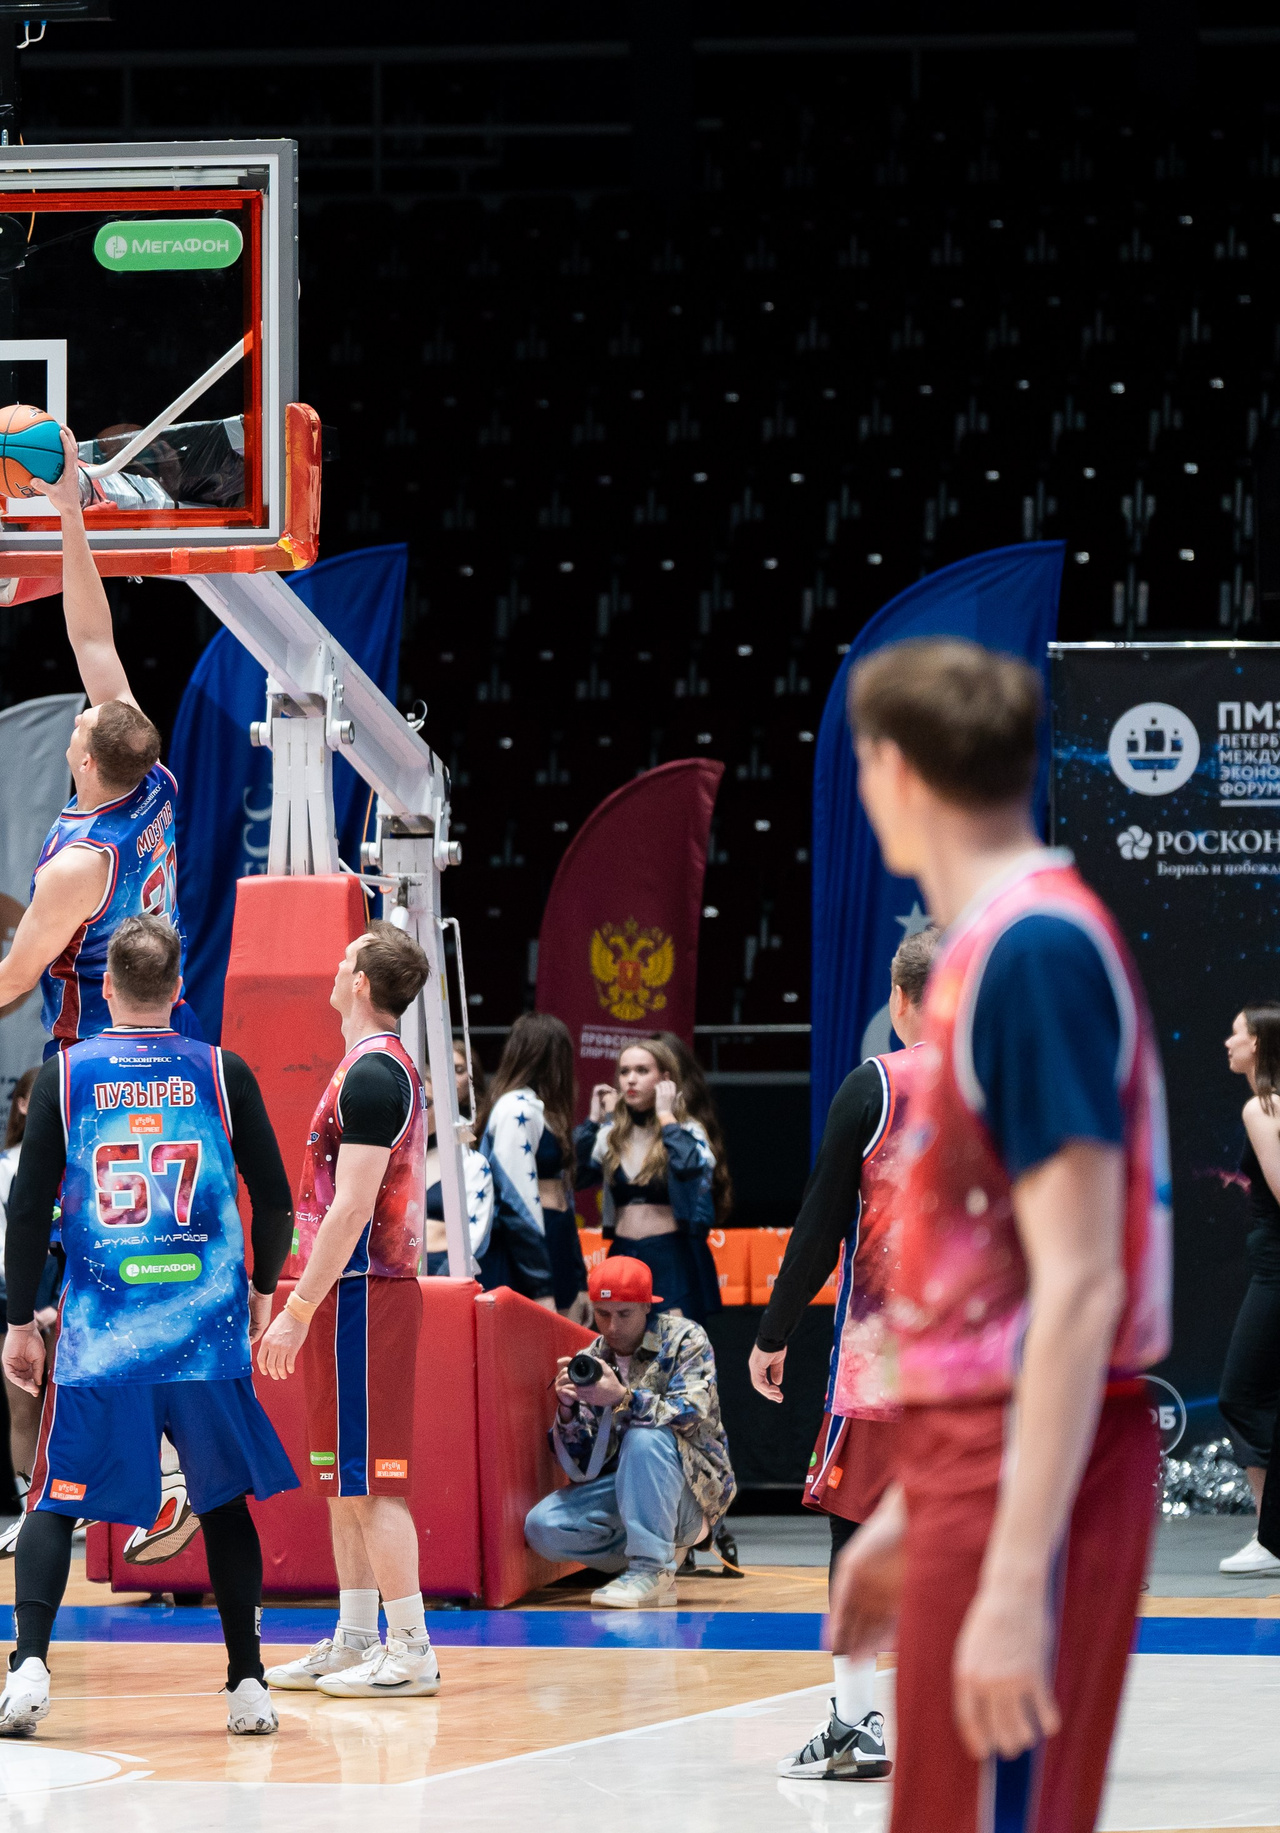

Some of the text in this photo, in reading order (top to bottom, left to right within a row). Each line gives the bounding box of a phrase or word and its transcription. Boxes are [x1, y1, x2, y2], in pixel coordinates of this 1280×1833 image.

[1220, 733, 1280, 749] ПЕТЕРБ
[136, 800, 173, 858] МОЗГОВ
[94, 1076, 196, 1110] ПУЗЫРЁВ
[94, 1235, 150, 1249] ДРУЖБА
